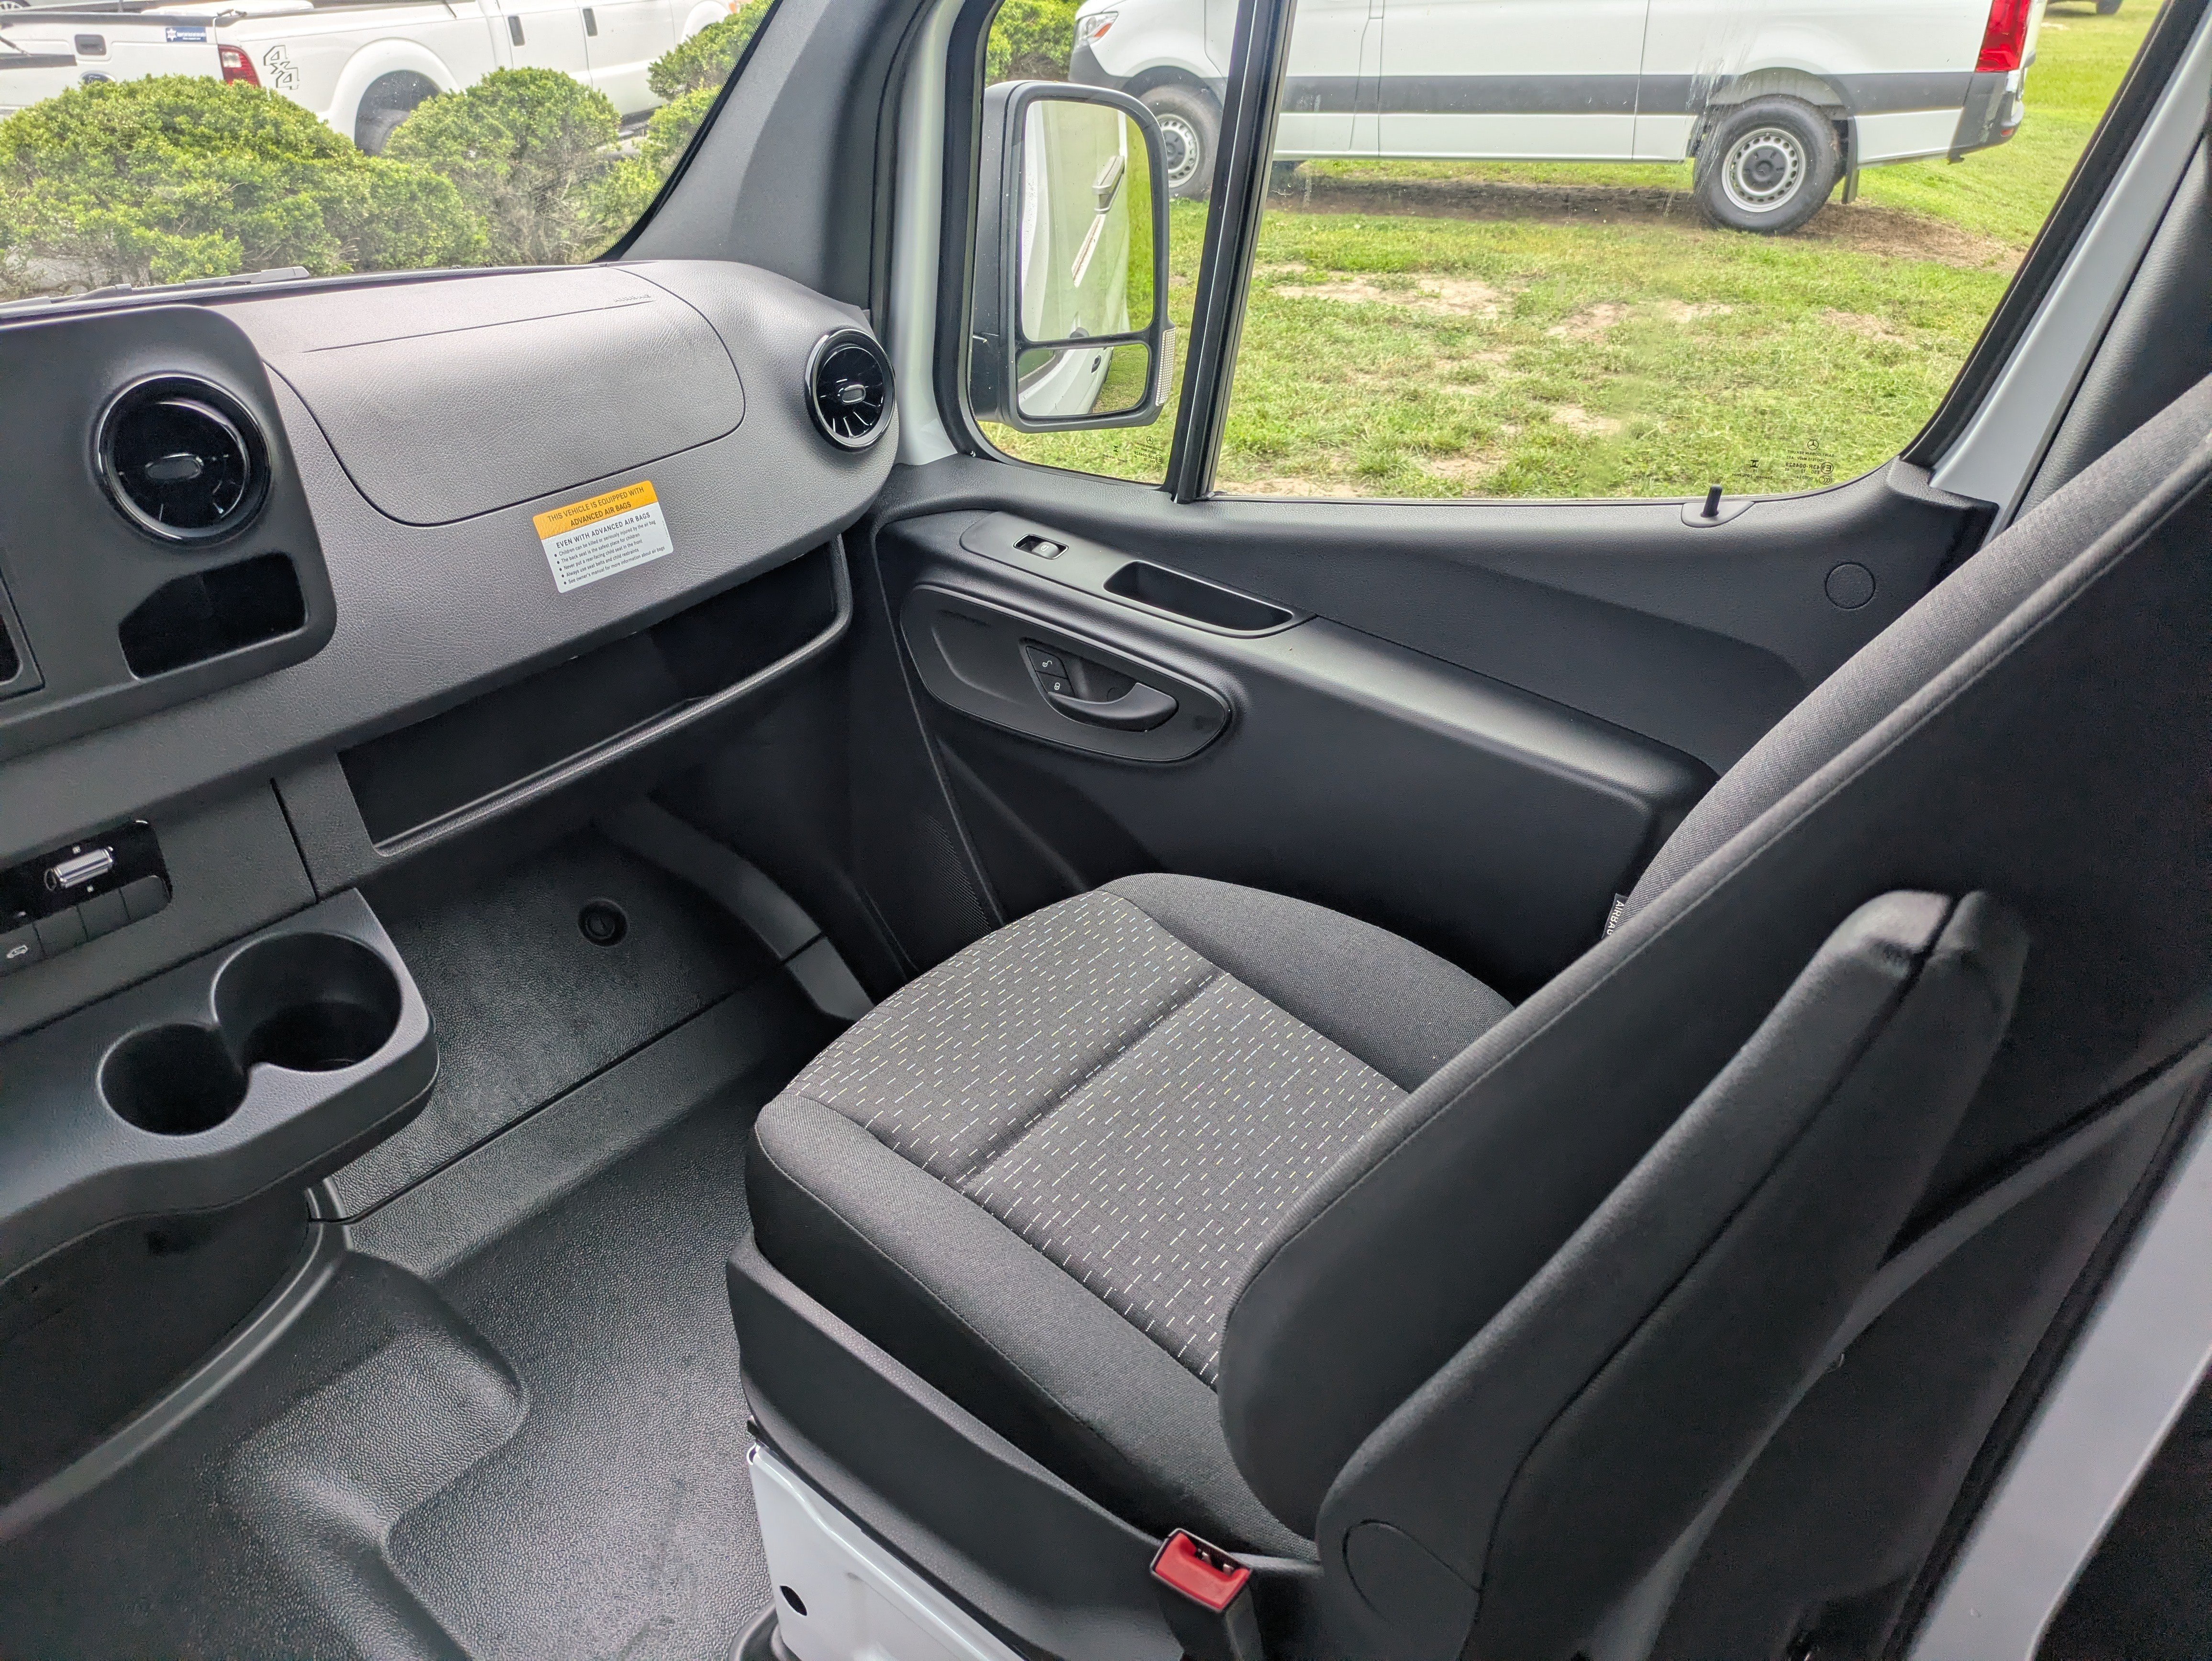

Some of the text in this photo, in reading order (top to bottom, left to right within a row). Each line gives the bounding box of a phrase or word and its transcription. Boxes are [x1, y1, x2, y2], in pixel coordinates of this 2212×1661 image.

[548, 512, 563, 522] THIS
[564, 504, 590, 517] VEHICLE
[598, 492, 628, 506] EQUIPPED
[629, 487, 644, 496] WITH
[570, 501, 631, 526] ADVANCED AIR BAGS
[557, 538, 573, 548] EVEN
[575, 532, 590, 542] WITH
[592, 521, 623, 536] ADVANCED
[636, 512, 650, 521] BAGS
[559, 547, 575, 556] Children
[603, 532, 620, 542] seriously
[620, 528, 632, 536] injured
[626, 532, 640, 541] children
[566, 568, 579, 577] Always
[622, 547, 639, 557] restraints
[576, 572, 590, 581] owner's
[591, 567, 605, 576] manual
[621, 554, 641, 565] information
[586, 552, 605, 563] rear-facing
[1607, 900, 1624, 935] AIRBAG
